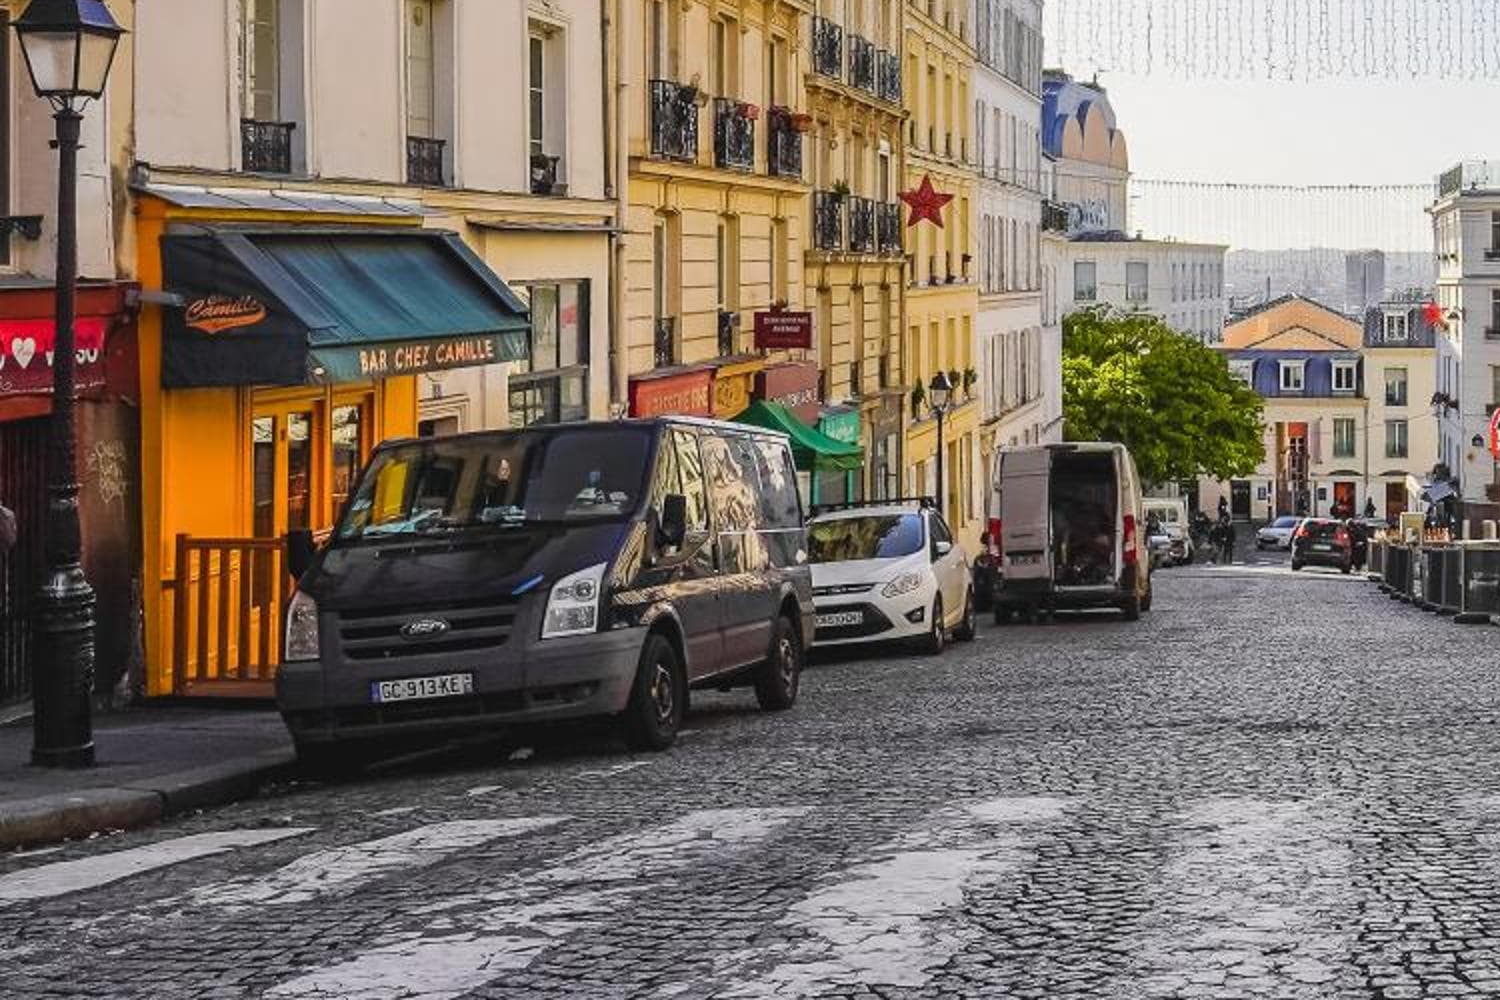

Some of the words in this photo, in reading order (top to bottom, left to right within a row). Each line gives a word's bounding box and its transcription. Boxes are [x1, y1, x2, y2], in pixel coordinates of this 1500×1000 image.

[359, 350, 388, 375] BAR
[394, 345, 429, 369] CHEZ
[435, 338, 494, 363] CAMILLE
